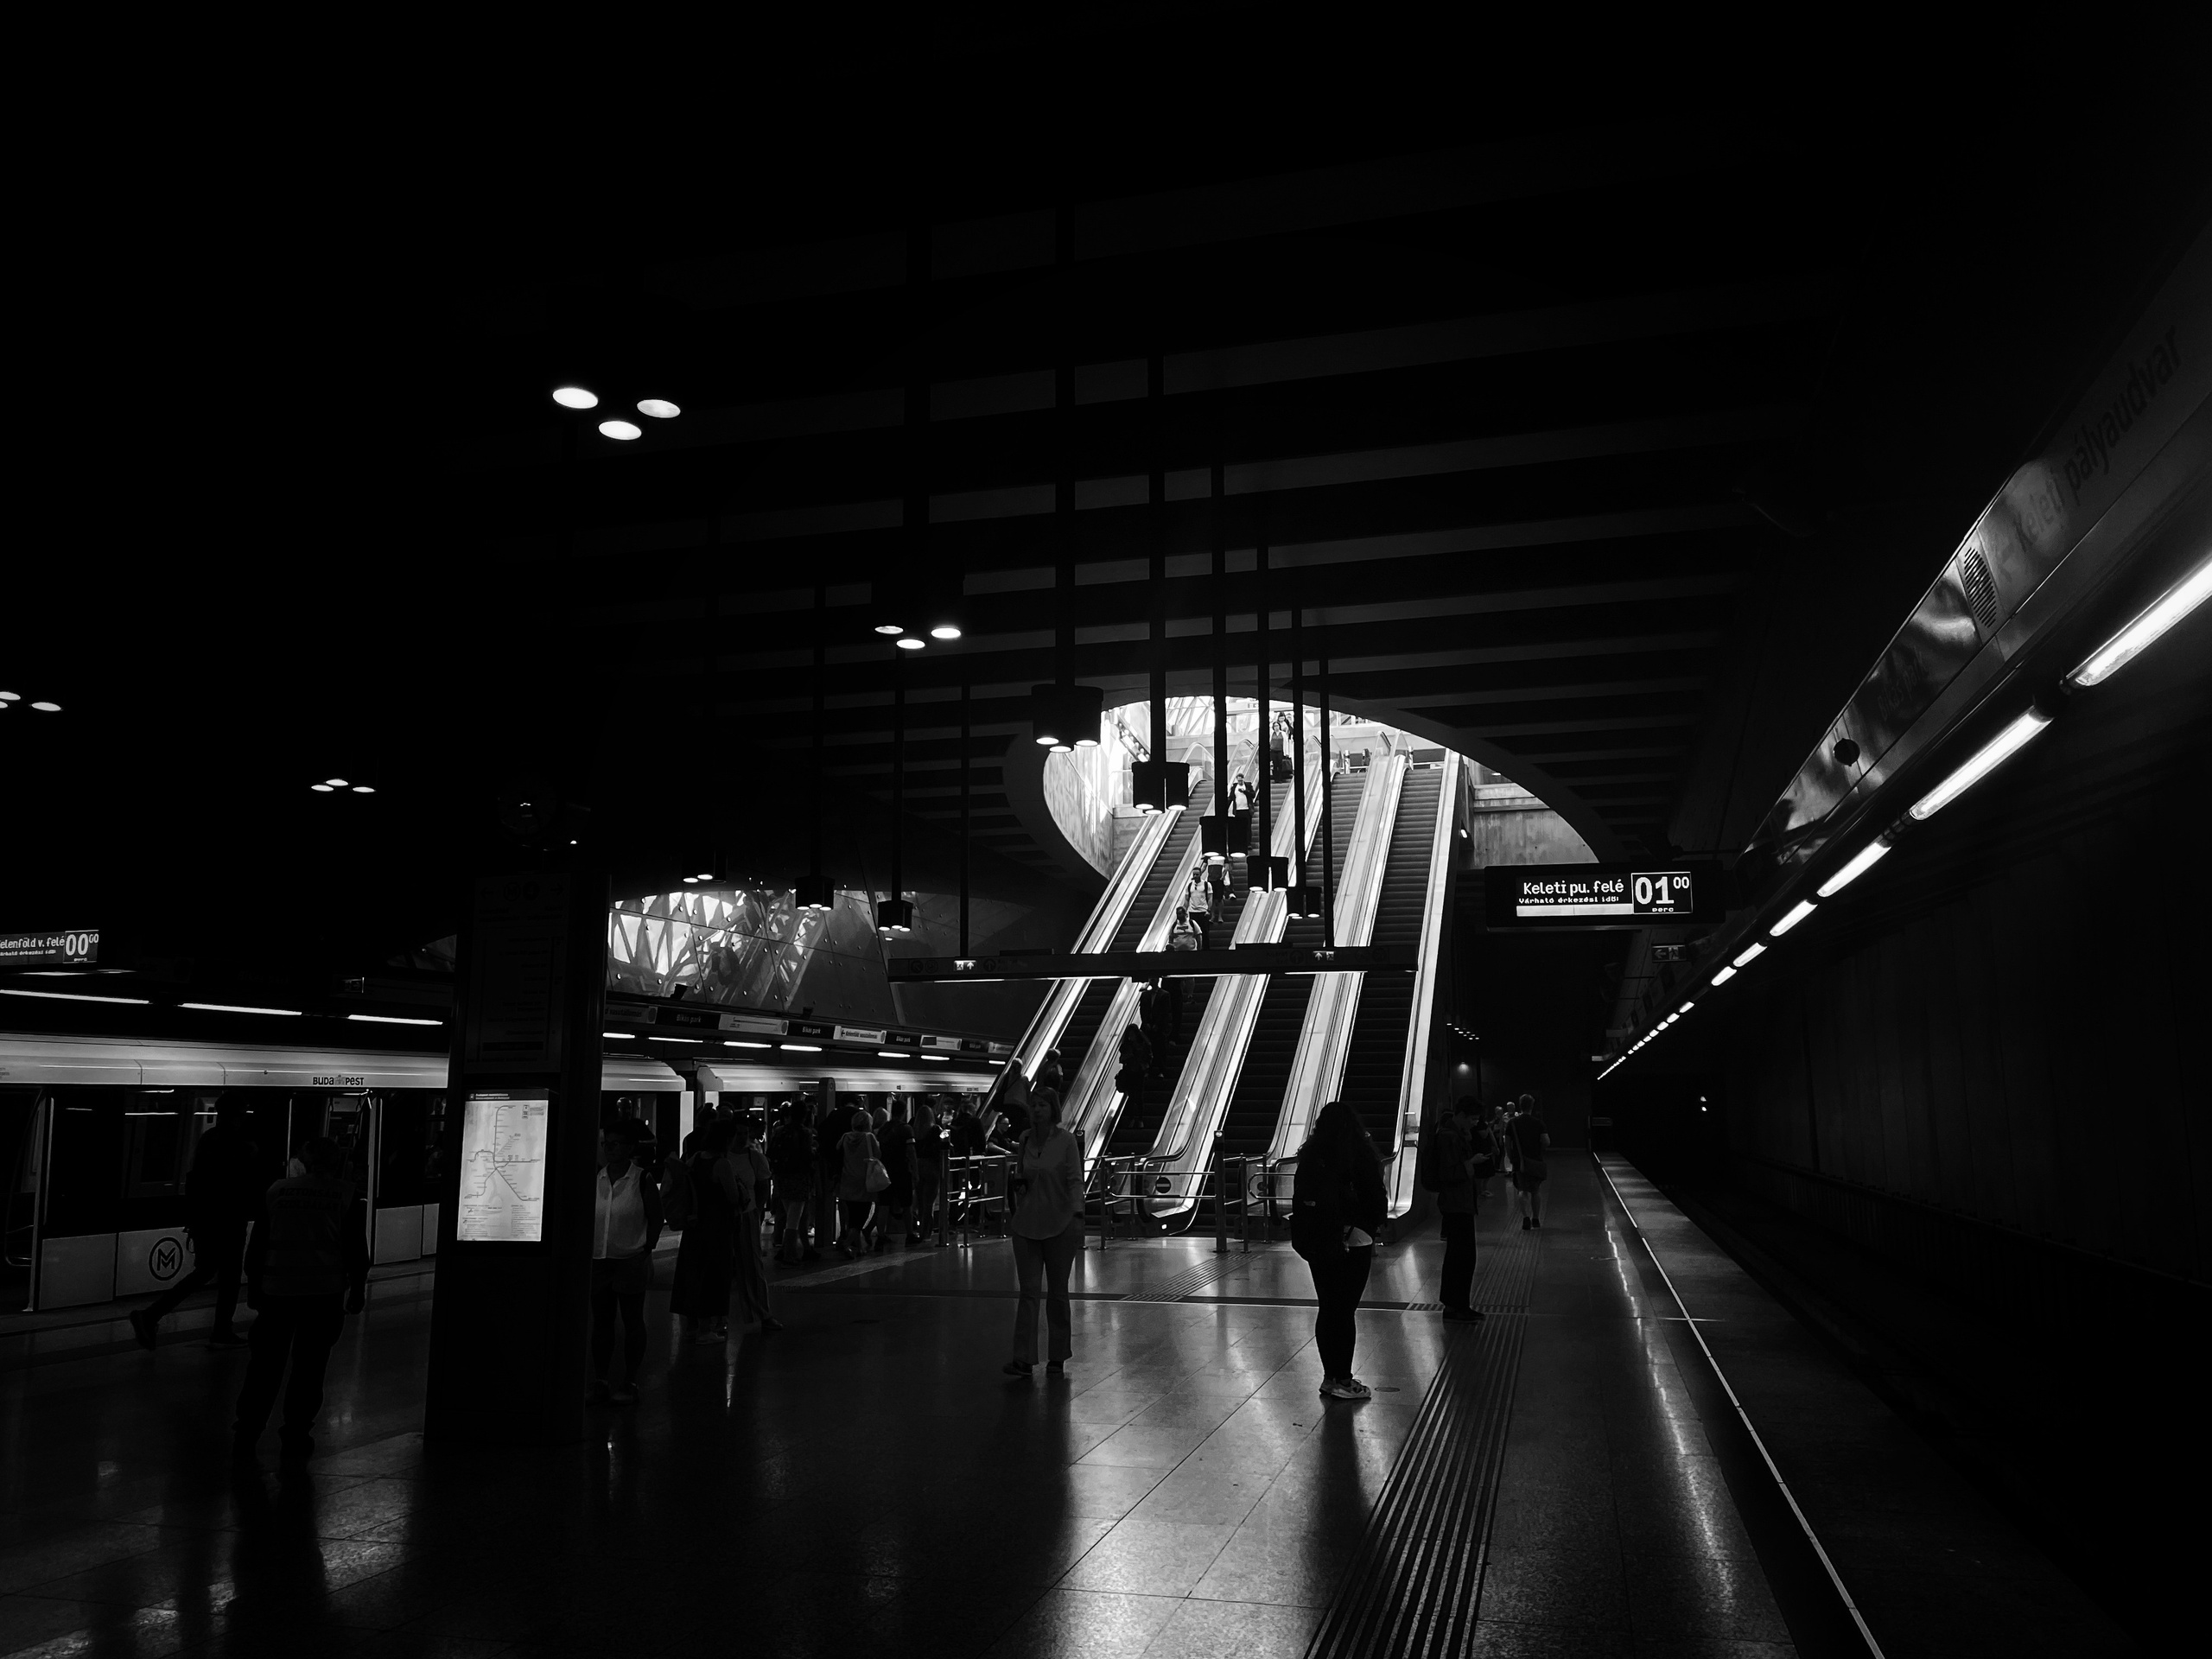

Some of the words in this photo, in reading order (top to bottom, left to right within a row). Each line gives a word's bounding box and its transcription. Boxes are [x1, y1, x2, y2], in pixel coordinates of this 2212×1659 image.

[2063, 325, 2180, 506] pályaudvar
[1523, 880, 1567, 895] Keleti
[1569, 882, 1590, 896] pu.
[1592, 879, 1624, 893] felé
[1635, 876, 1674, 905] 01
[1673, 876, 1690, 889] 00
[0, 938, 36, 949] elenföld
[47, 936, 65, 947] felé
[66, 934, 88, 956] 00
